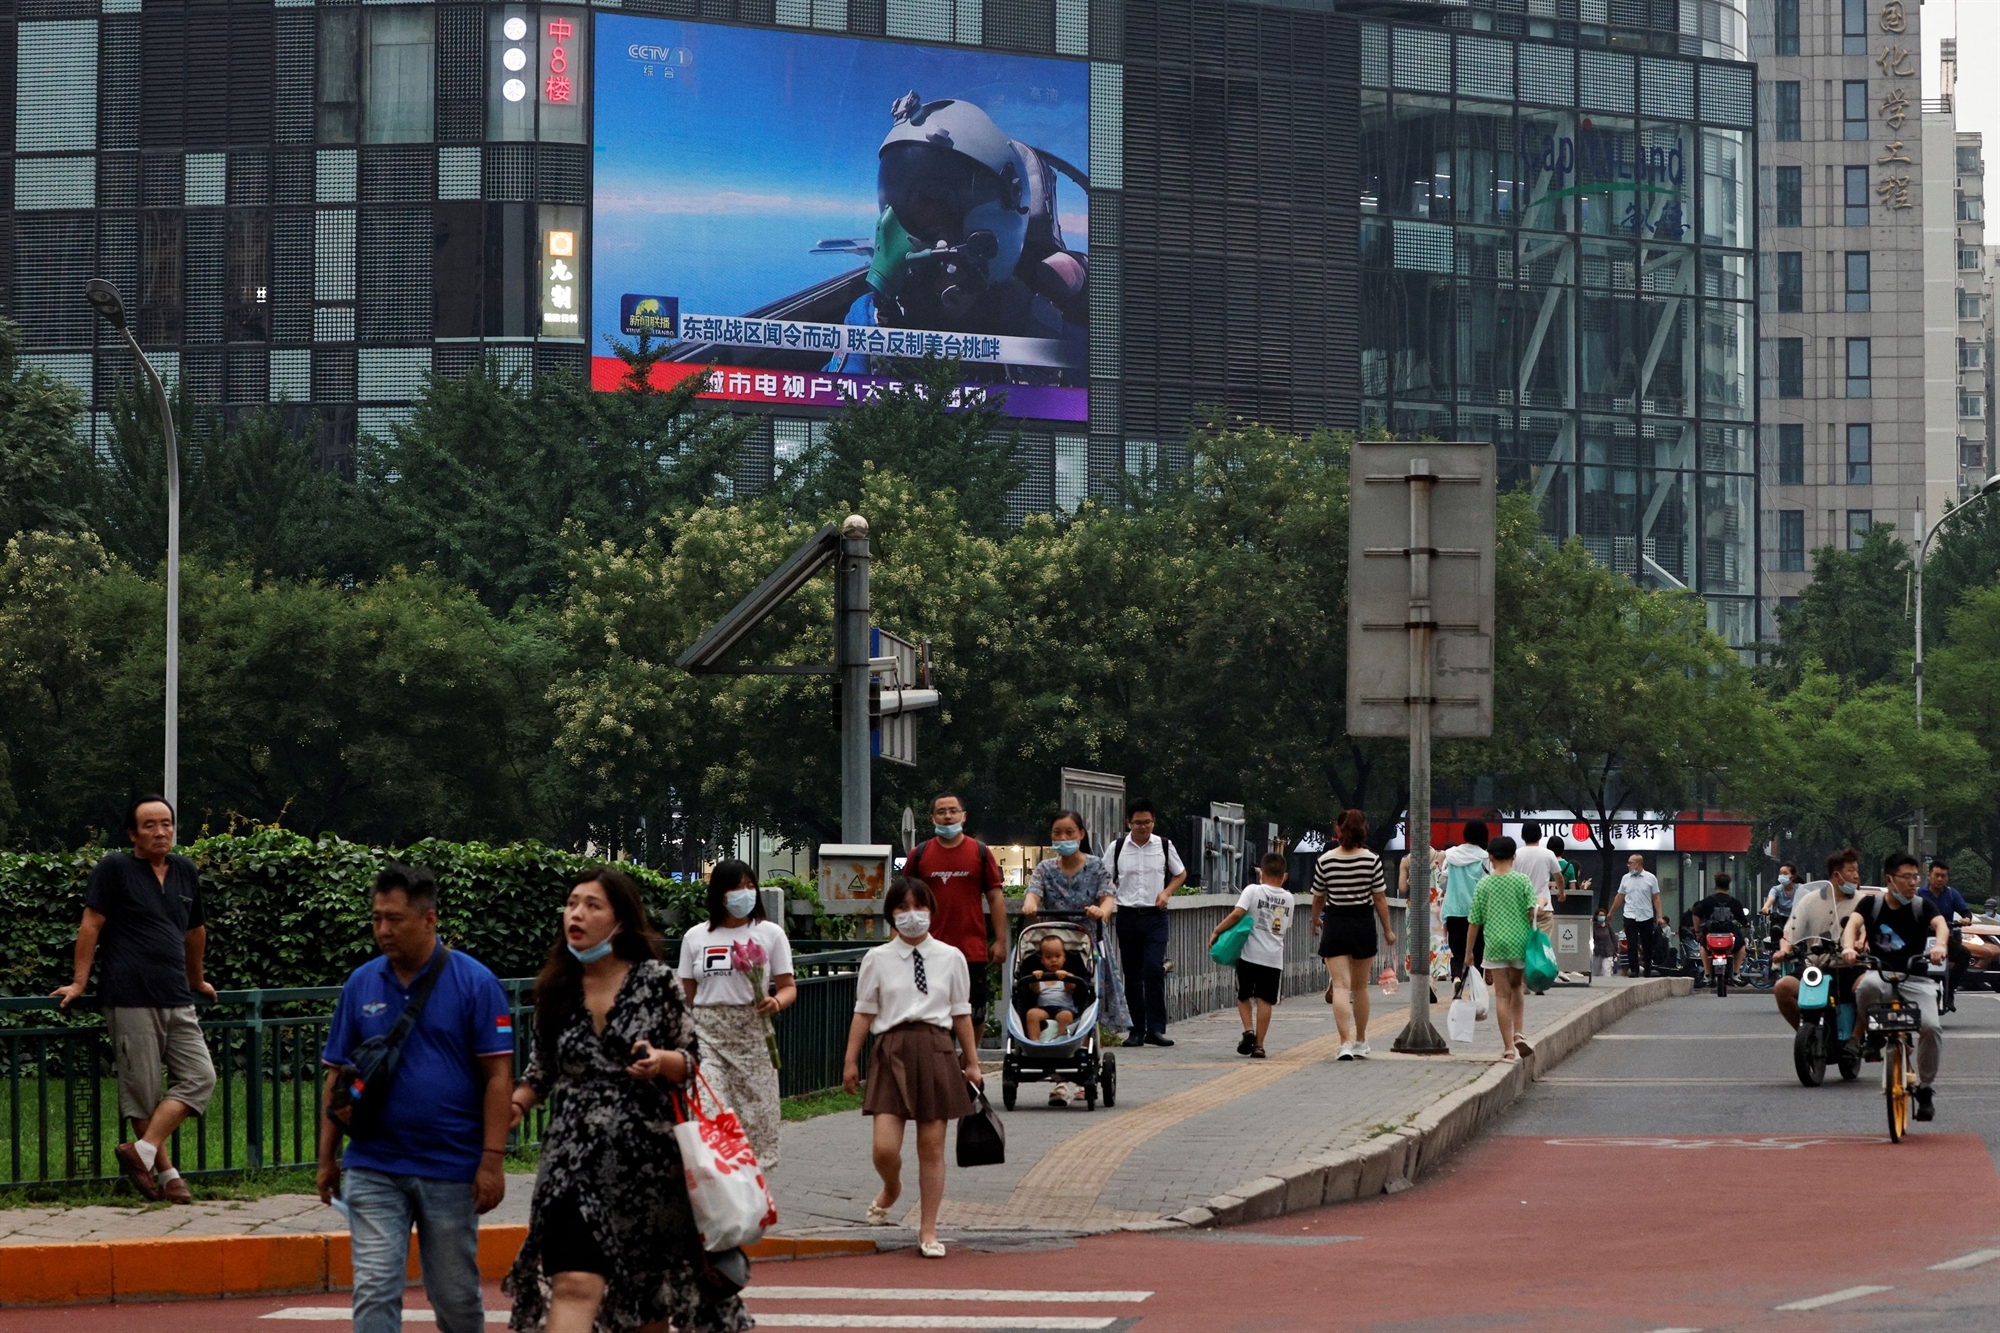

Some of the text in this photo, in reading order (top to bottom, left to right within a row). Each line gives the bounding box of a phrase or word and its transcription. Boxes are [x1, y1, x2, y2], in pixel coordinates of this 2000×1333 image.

[546, 17, 573, 102] 中8楼
[628, 44, 669, 61] CCTV
[682, 315, 1001, 361] 东部战区闻令而动 联合反制美台挑衅
